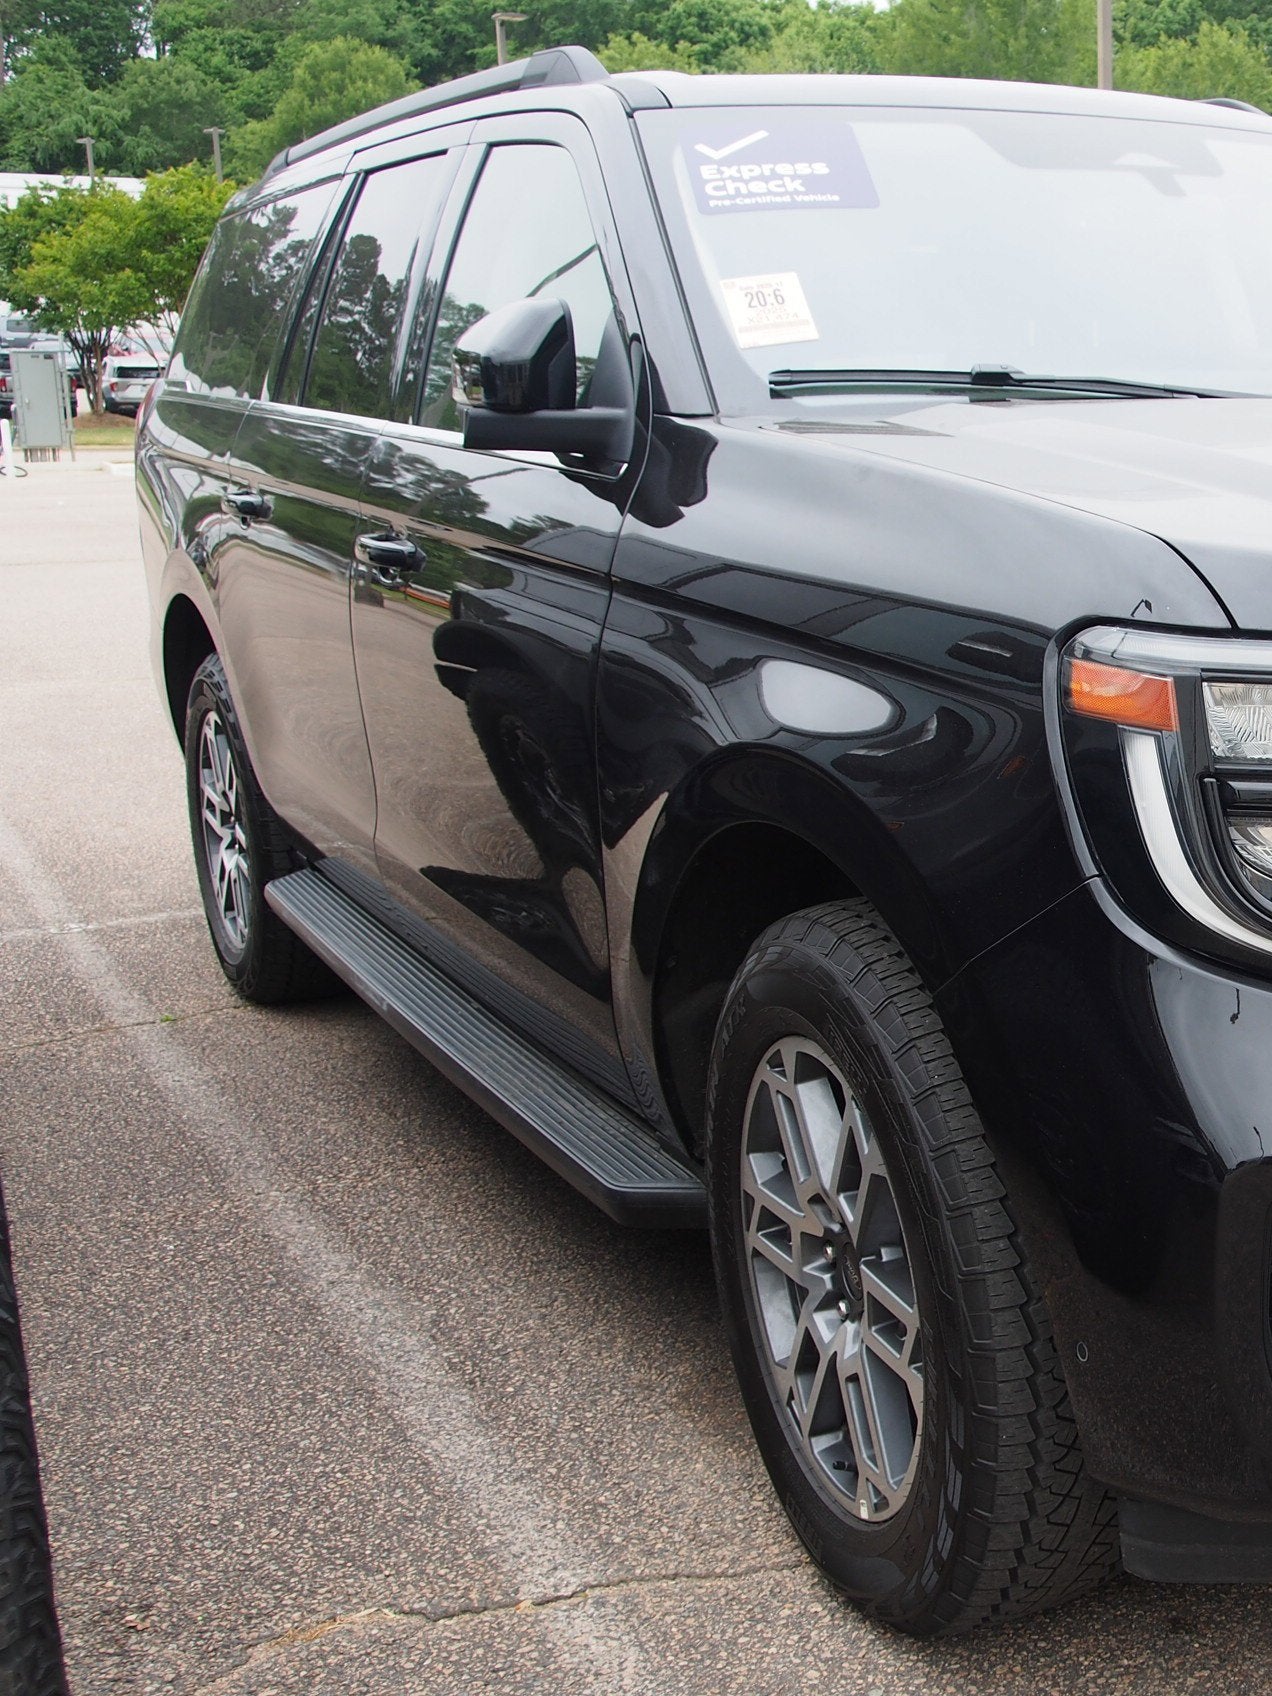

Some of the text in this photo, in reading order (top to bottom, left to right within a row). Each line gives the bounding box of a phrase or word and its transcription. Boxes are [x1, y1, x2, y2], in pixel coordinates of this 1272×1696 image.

[700, 162, 830, 180] Express
[705, 177, 806, 196] Check
[794, 194, 840, 203] Vehicle
